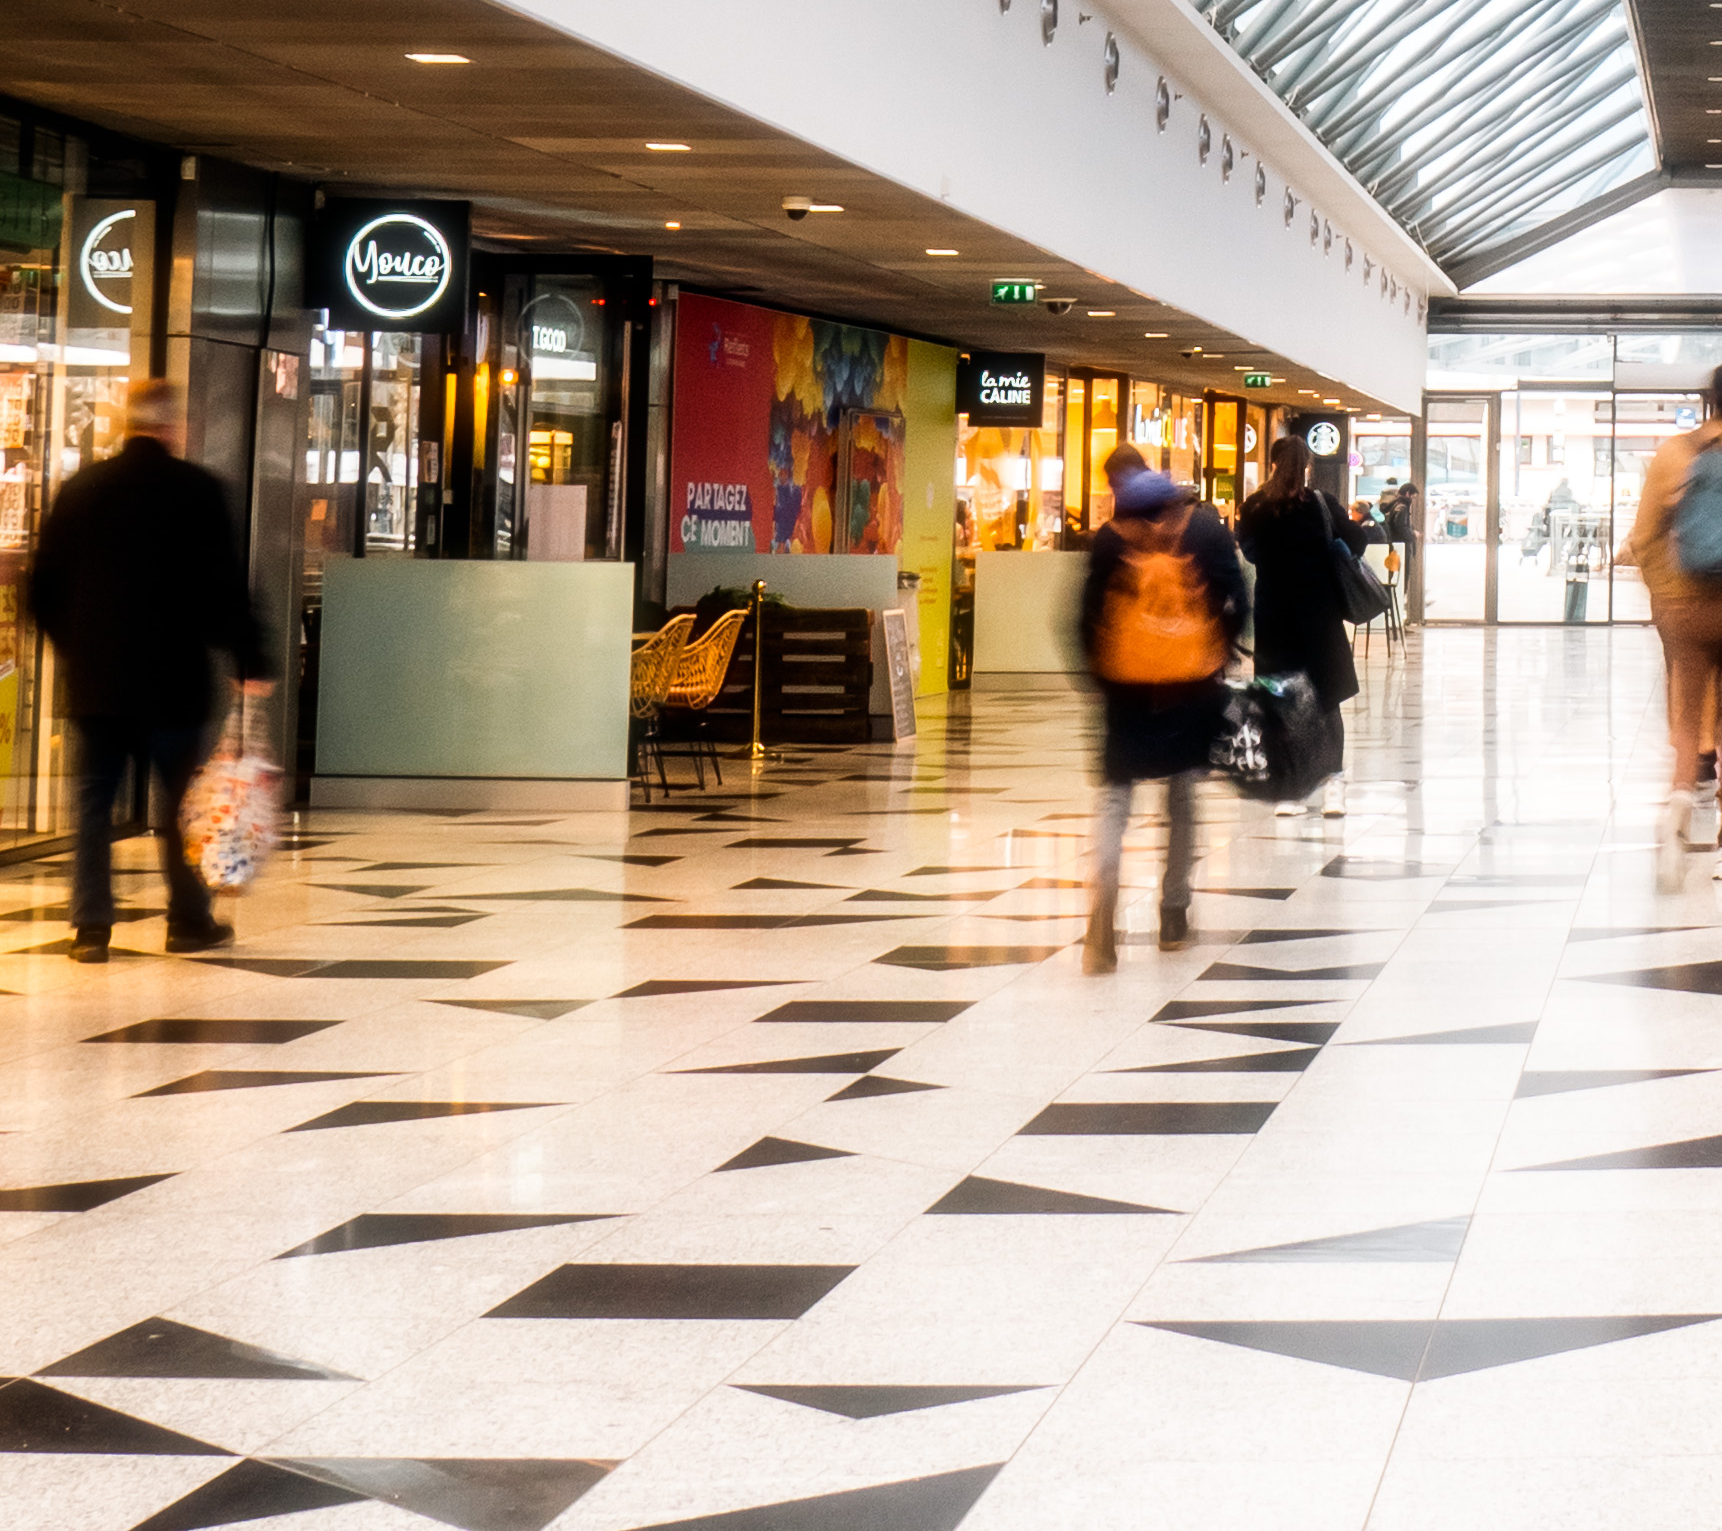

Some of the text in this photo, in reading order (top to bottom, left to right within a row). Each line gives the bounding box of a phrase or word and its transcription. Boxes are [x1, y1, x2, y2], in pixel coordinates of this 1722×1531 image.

[353, 240, 444, 284] Youco
[981, 370, 1031, 388] la mie
[687, 482, 747, 511] PARTAGEZ
[681, 514, 750, 547] CE MOMENT
